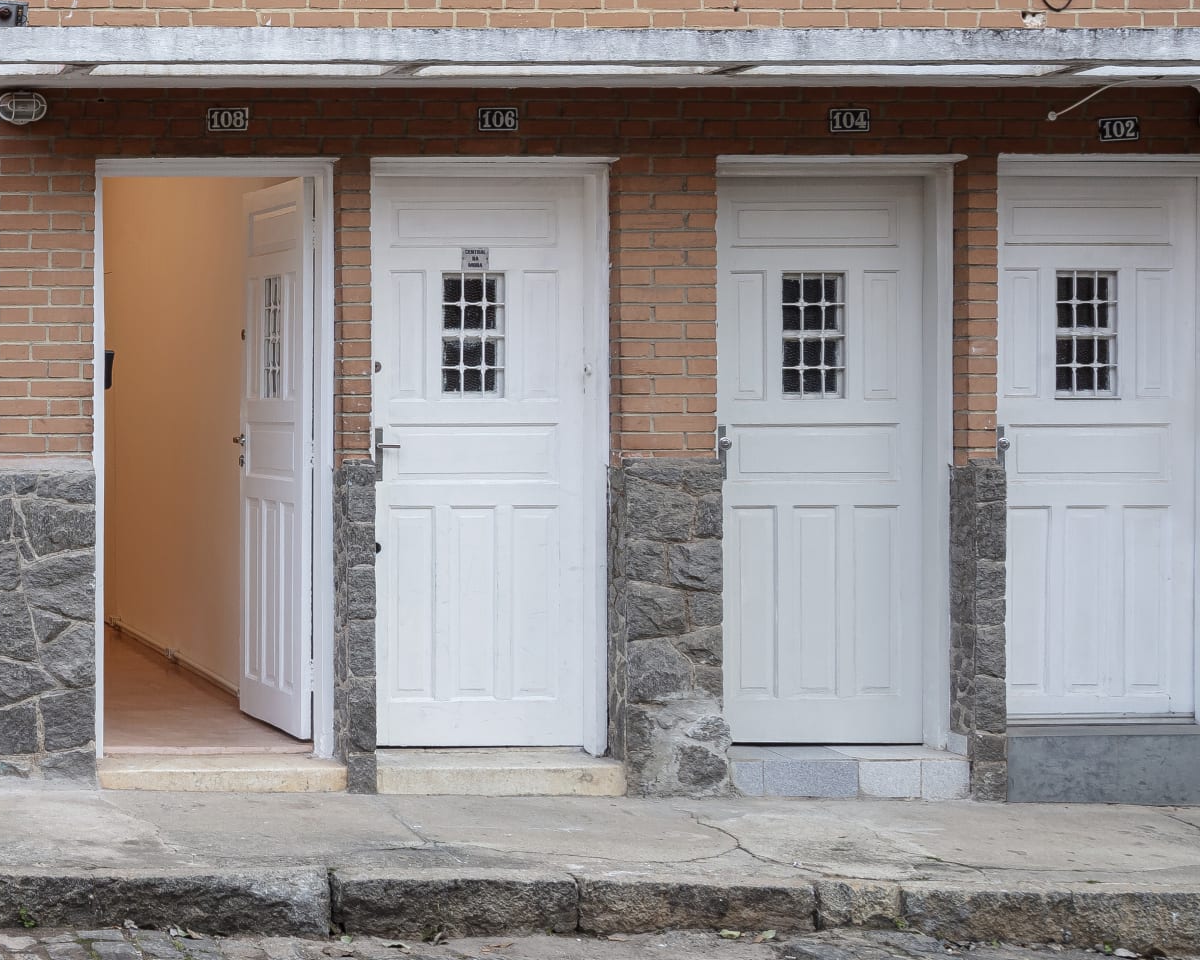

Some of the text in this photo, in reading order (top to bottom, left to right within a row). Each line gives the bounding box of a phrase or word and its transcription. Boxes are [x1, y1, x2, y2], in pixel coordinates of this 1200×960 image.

[211, 110, 245, 128] 108
[482, 110, 516, 128] 106
[833, 112, 867, 129] 104
[1103, 120, 1136, 138] 102
